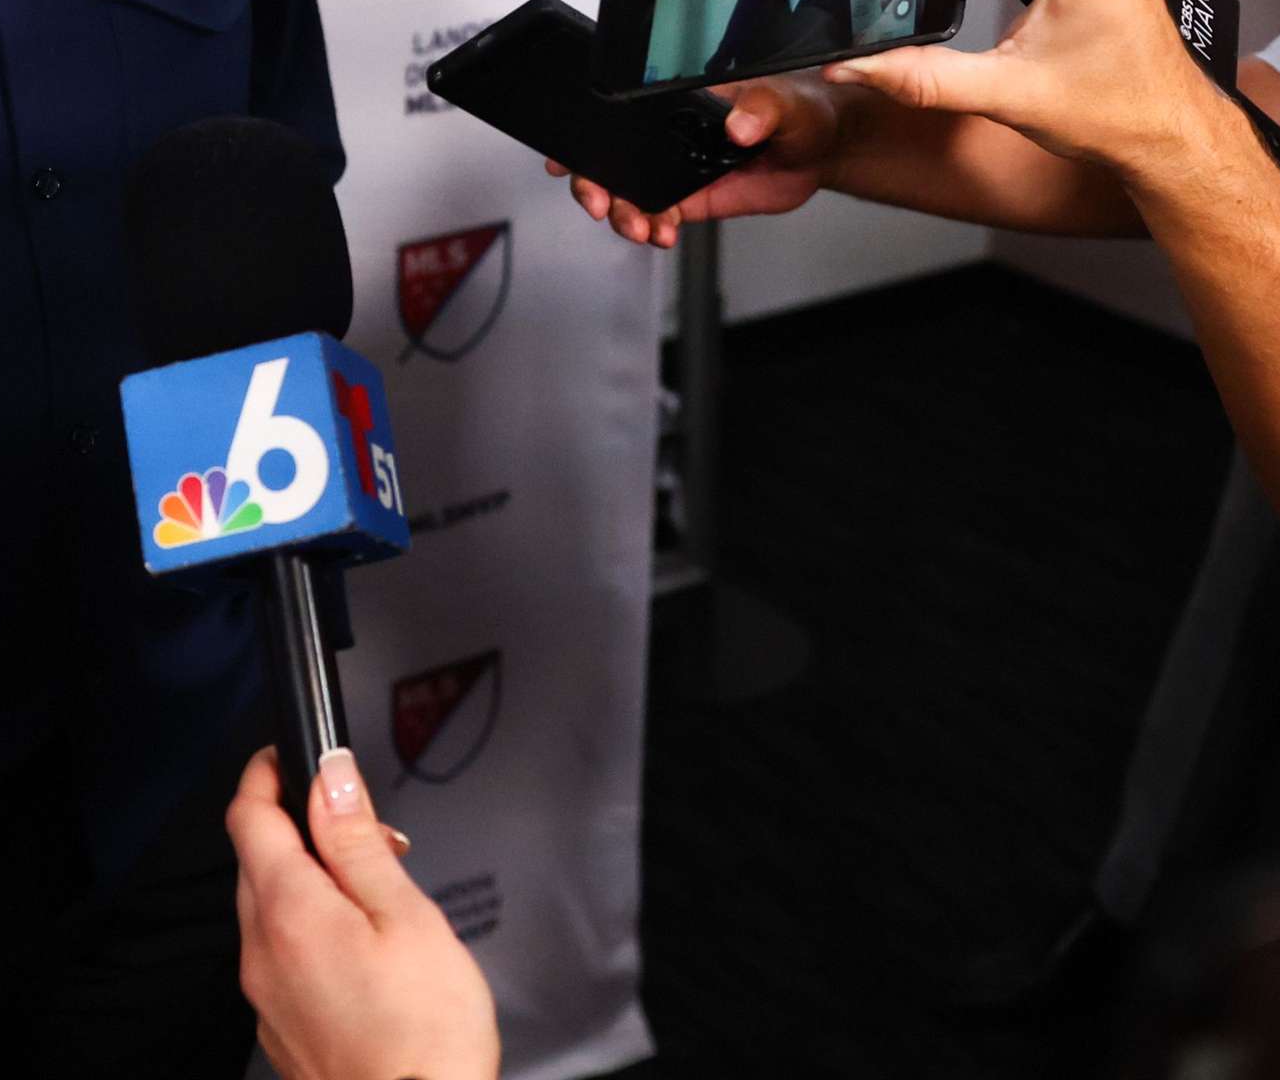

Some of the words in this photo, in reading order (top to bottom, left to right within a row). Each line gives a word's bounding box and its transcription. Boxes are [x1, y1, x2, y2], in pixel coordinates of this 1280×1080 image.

[1181, 1, 1194, 30] CBS
[225, 357, 329, 524] 6
[371, 443, 404, 517] 51
